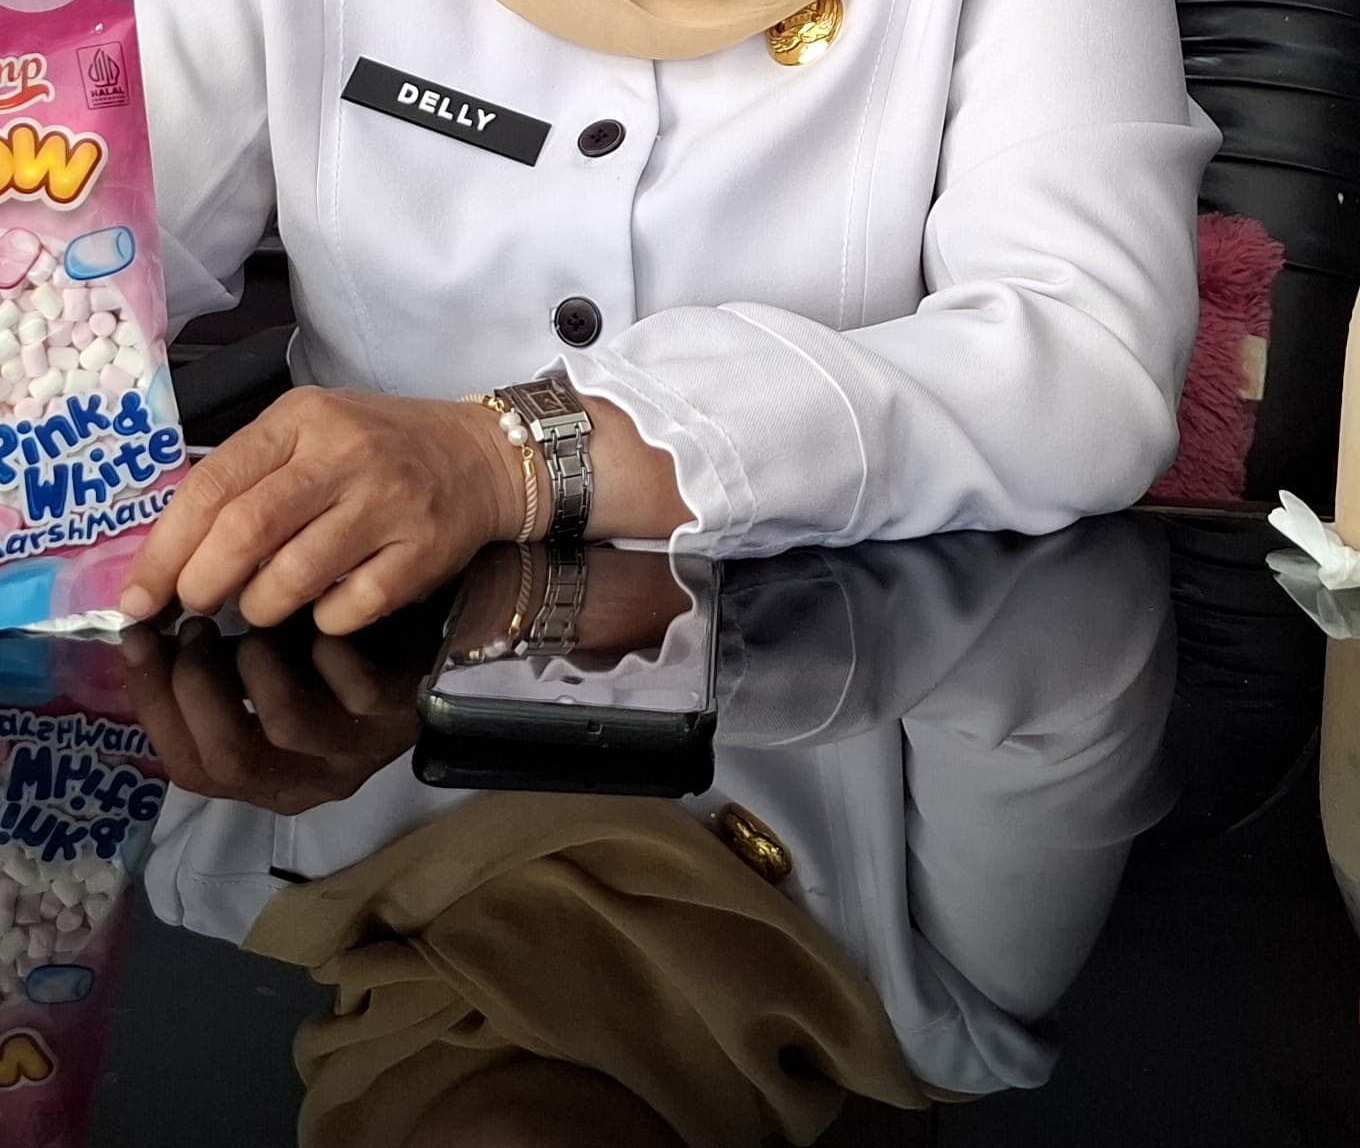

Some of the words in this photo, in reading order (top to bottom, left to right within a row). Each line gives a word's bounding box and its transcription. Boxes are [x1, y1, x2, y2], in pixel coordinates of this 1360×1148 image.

[90, 86, 125, 98] HALAL
[397, 82, 496, 132] DELLY
[25, 427, 182, 521] White
